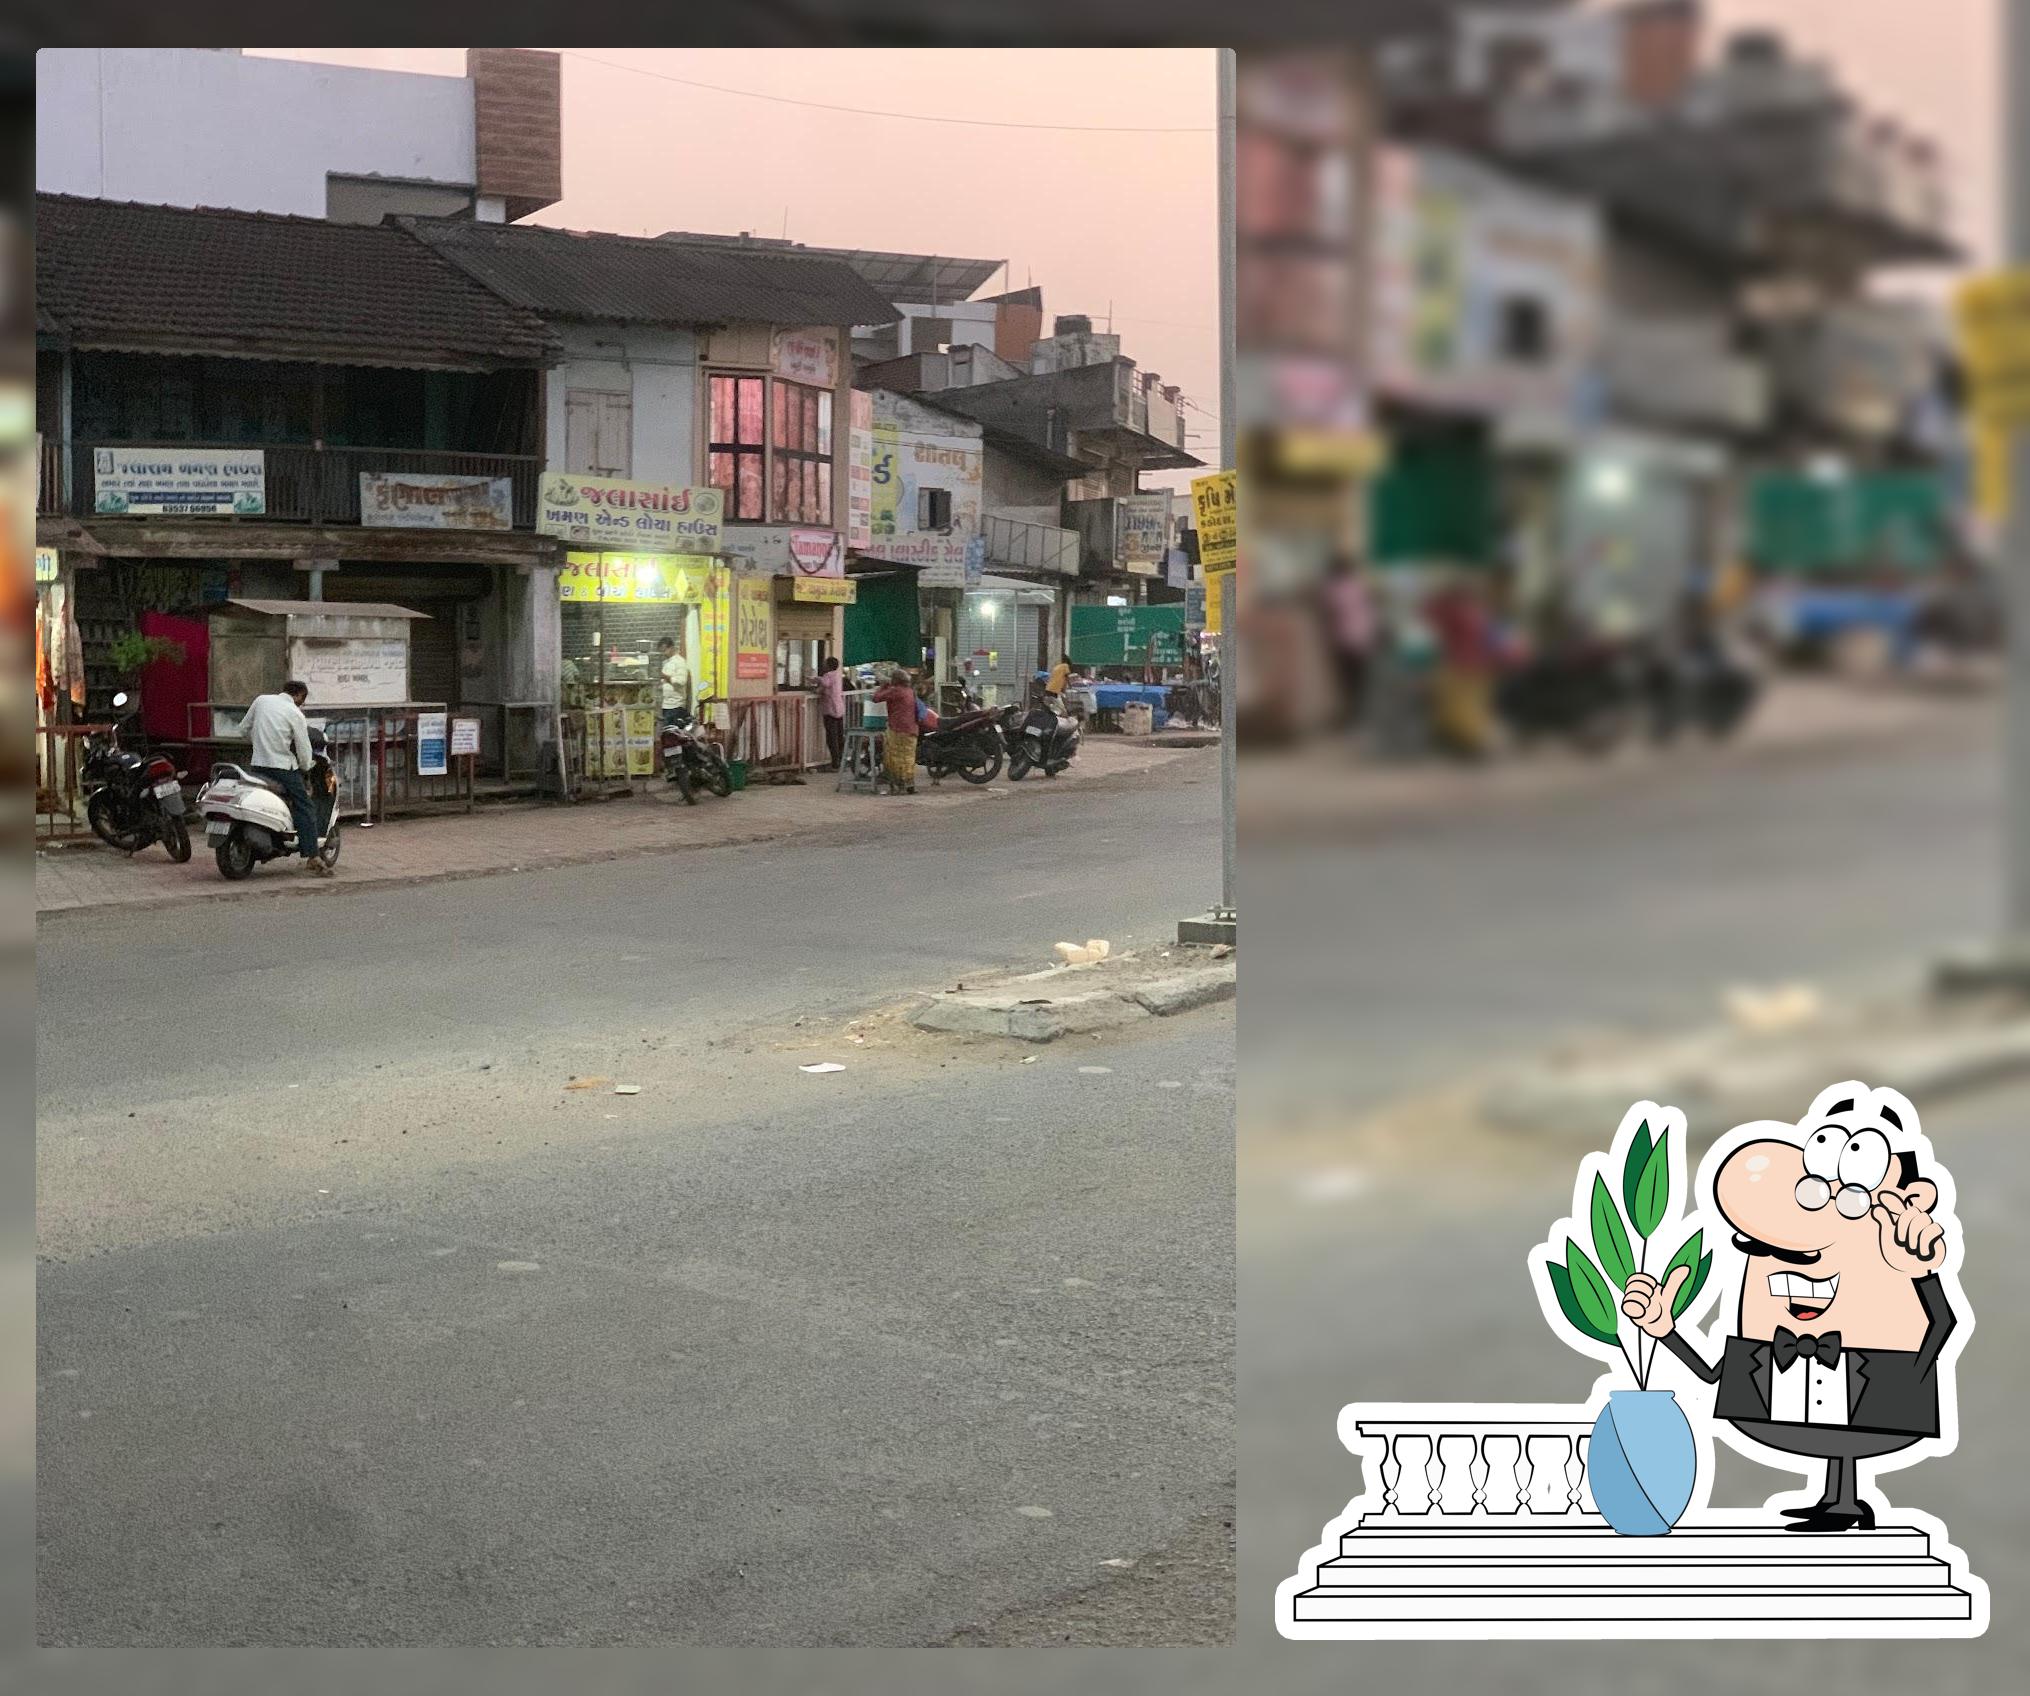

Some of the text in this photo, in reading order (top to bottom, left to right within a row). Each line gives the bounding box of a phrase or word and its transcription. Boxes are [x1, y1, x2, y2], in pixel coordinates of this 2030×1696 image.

[580, 486, 692, 514] જલાસાંઈ
[546, 509, 589, 524] ખમણ
[595, 509, 630, 528] એન્ડ
